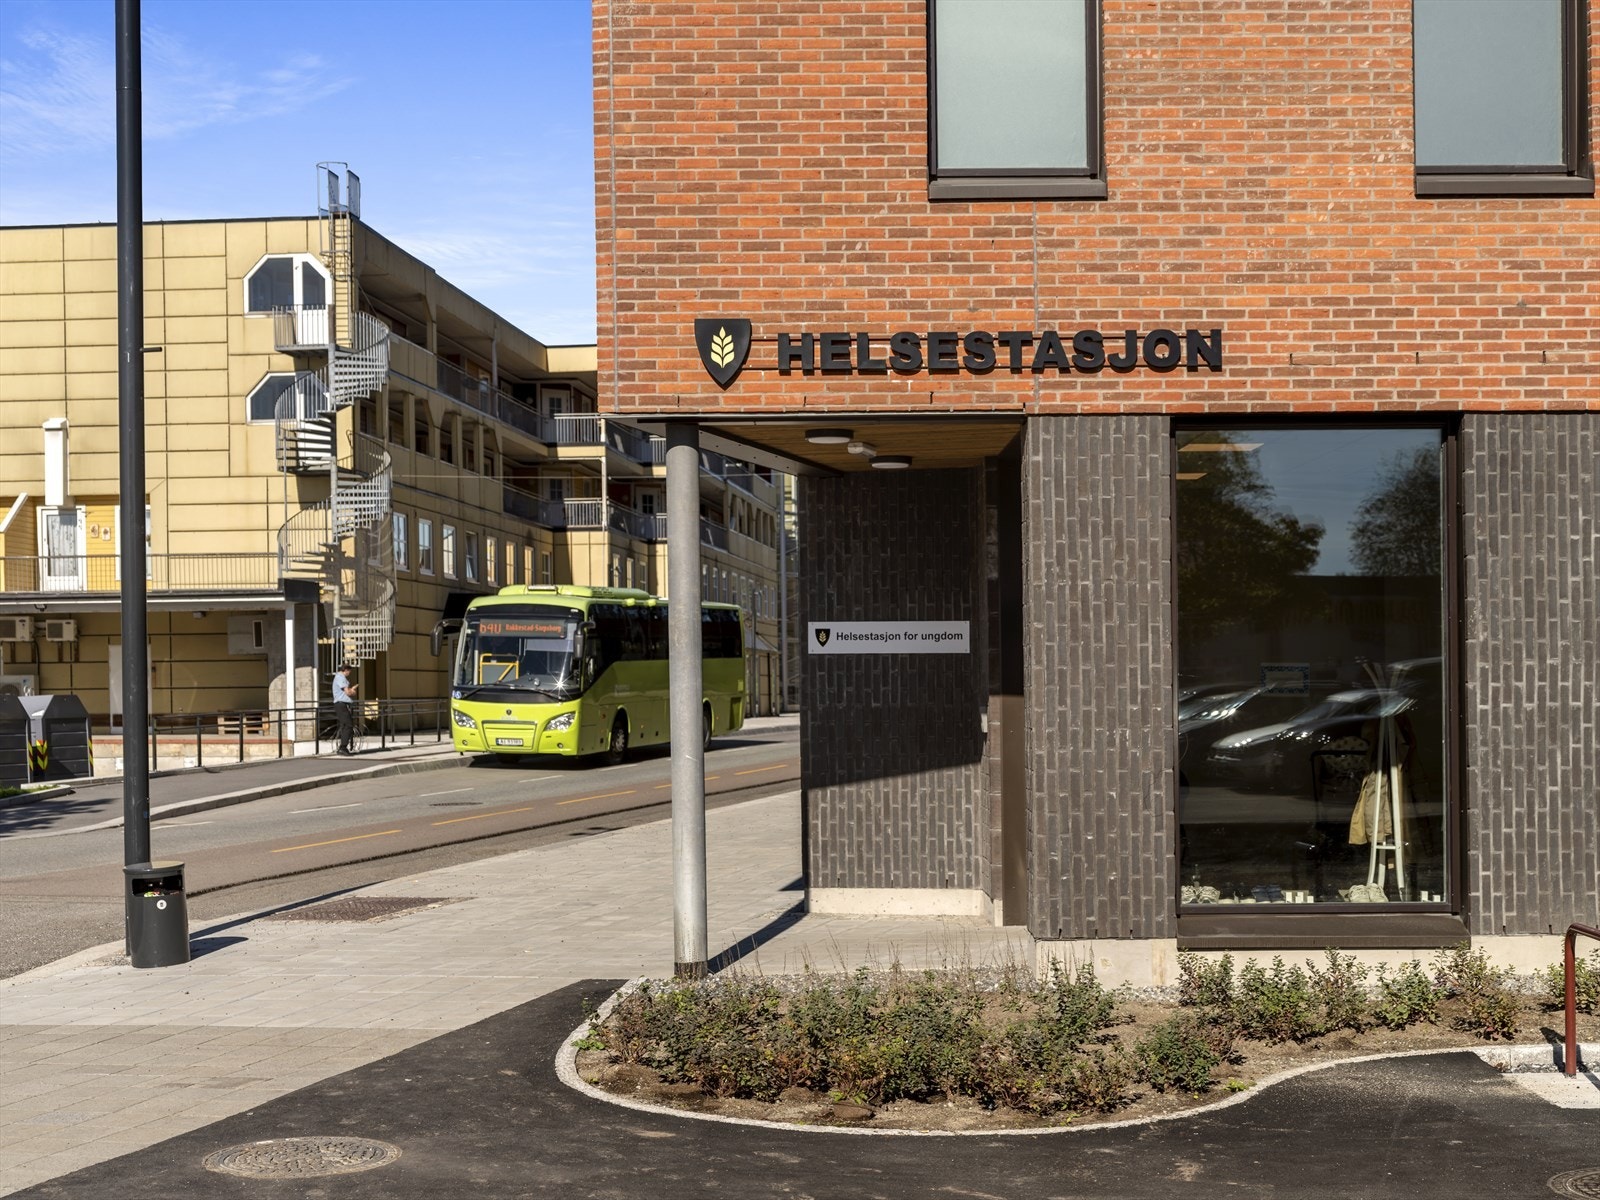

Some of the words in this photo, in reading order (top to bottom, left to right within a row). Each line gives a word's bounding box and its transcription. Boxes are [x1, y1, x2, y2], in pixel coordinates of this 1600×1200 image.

[778, 329, 1222, 376] HELSESTASJON
[836, 631, 901, 643] Helsestasjon
[904, 631, 918, 640] for
[921, 631, 963, 643] ungdom
